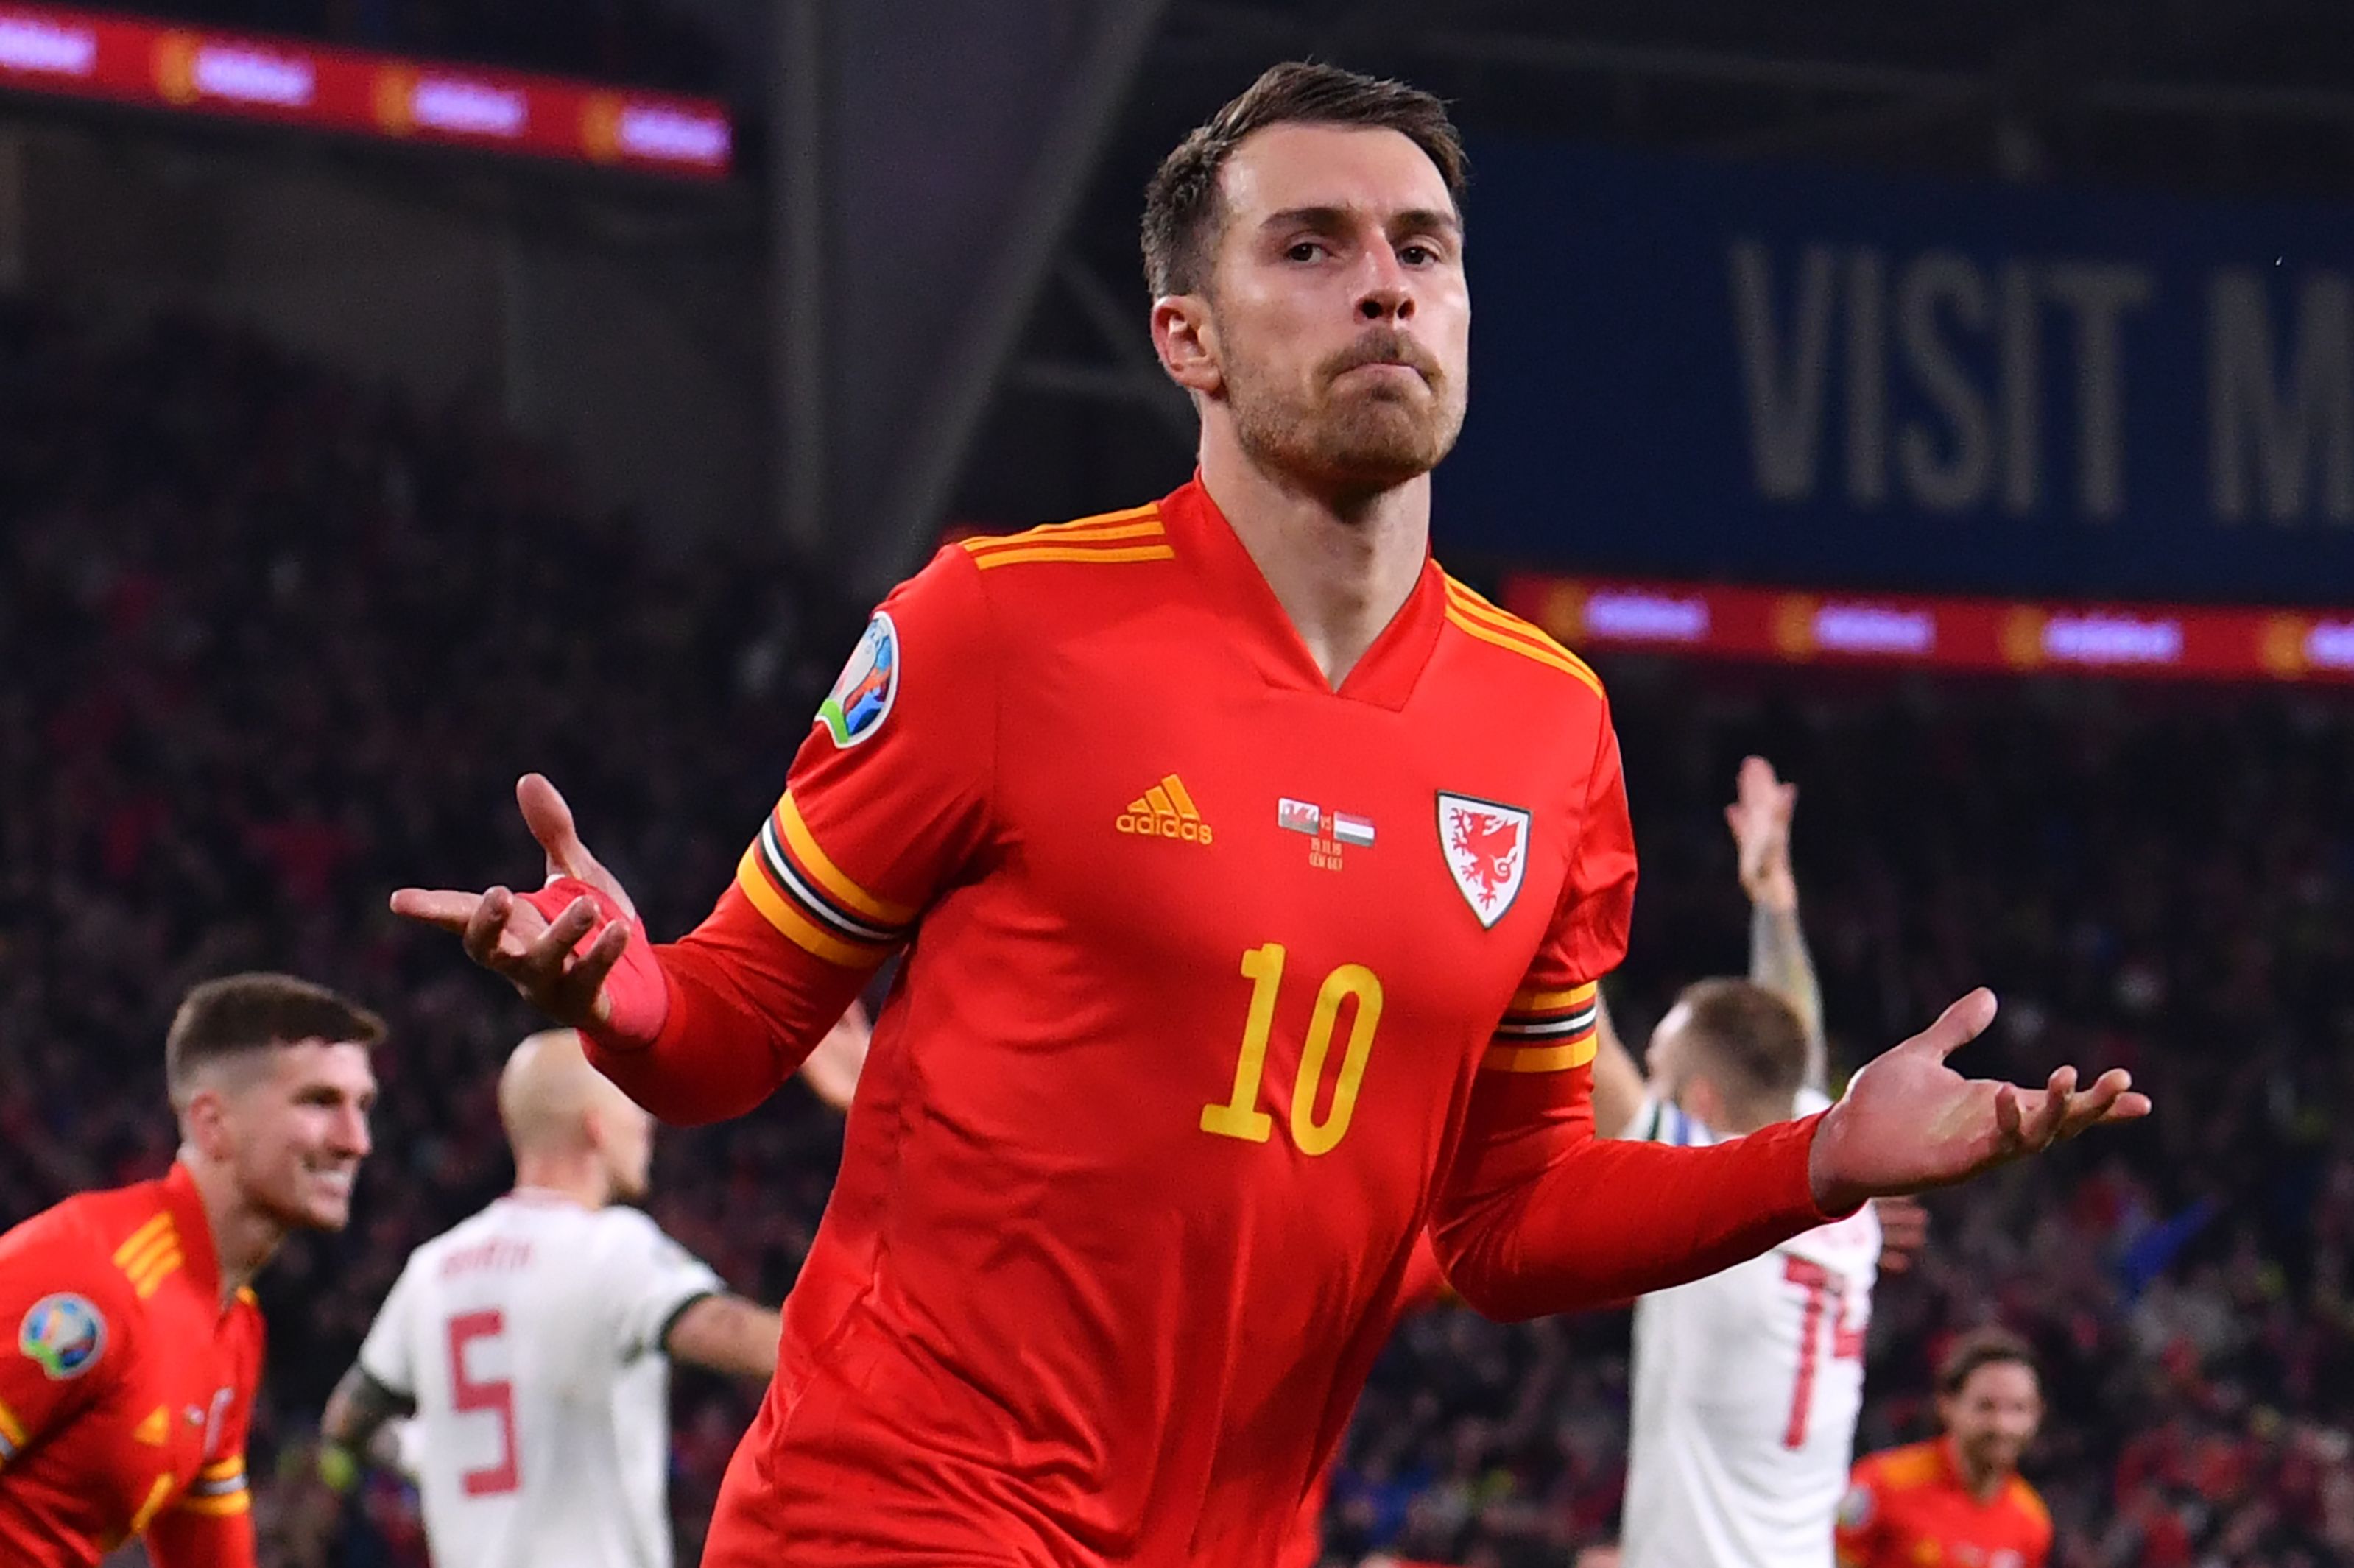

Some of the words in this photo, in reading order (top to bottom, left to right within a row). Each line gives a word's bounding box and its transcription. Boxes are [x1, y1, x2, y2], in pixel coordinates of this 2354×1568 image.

[1730, 241, 2152, 517] VISIT
[1116, 809, 1213, 845] adidas
[1200, 942, 1384, 1156] 10
[448, 1310, 519, 1495] 5
